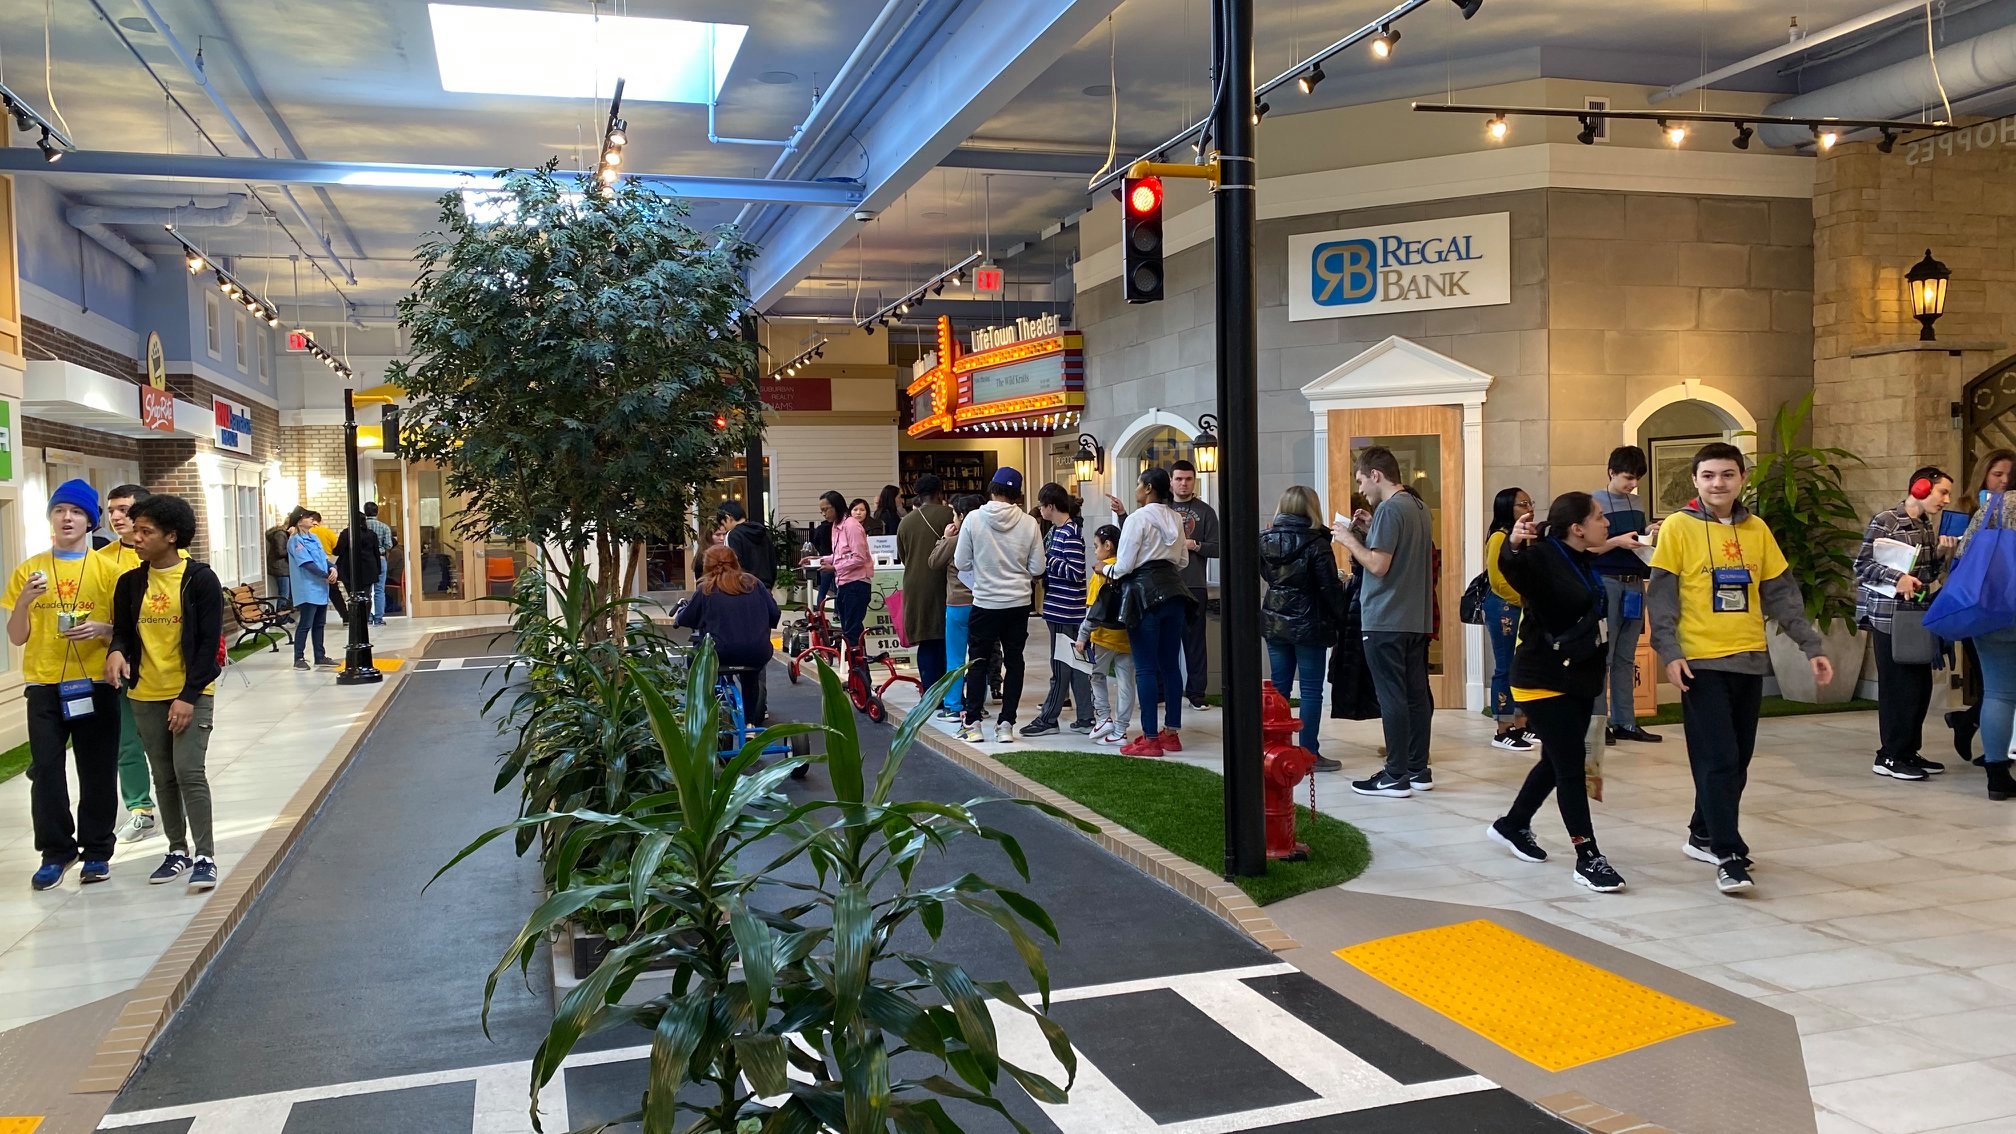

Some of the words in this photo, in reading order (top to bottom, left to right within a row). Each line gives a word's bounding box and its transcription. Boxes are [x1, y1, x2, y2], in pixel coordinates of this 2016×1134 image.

[1379, 235, 1483, 268] REGAL
[977, 271, 1002, 291] EXIT
[1379, 269, 1470, 302] BANK
[971, 325, 1017, 353] LifeTown
[1016, 311, 1061, 341] Theater
[145, 393, 173, 424] ShopRite
[878, 640, 900, 649] $1.0
